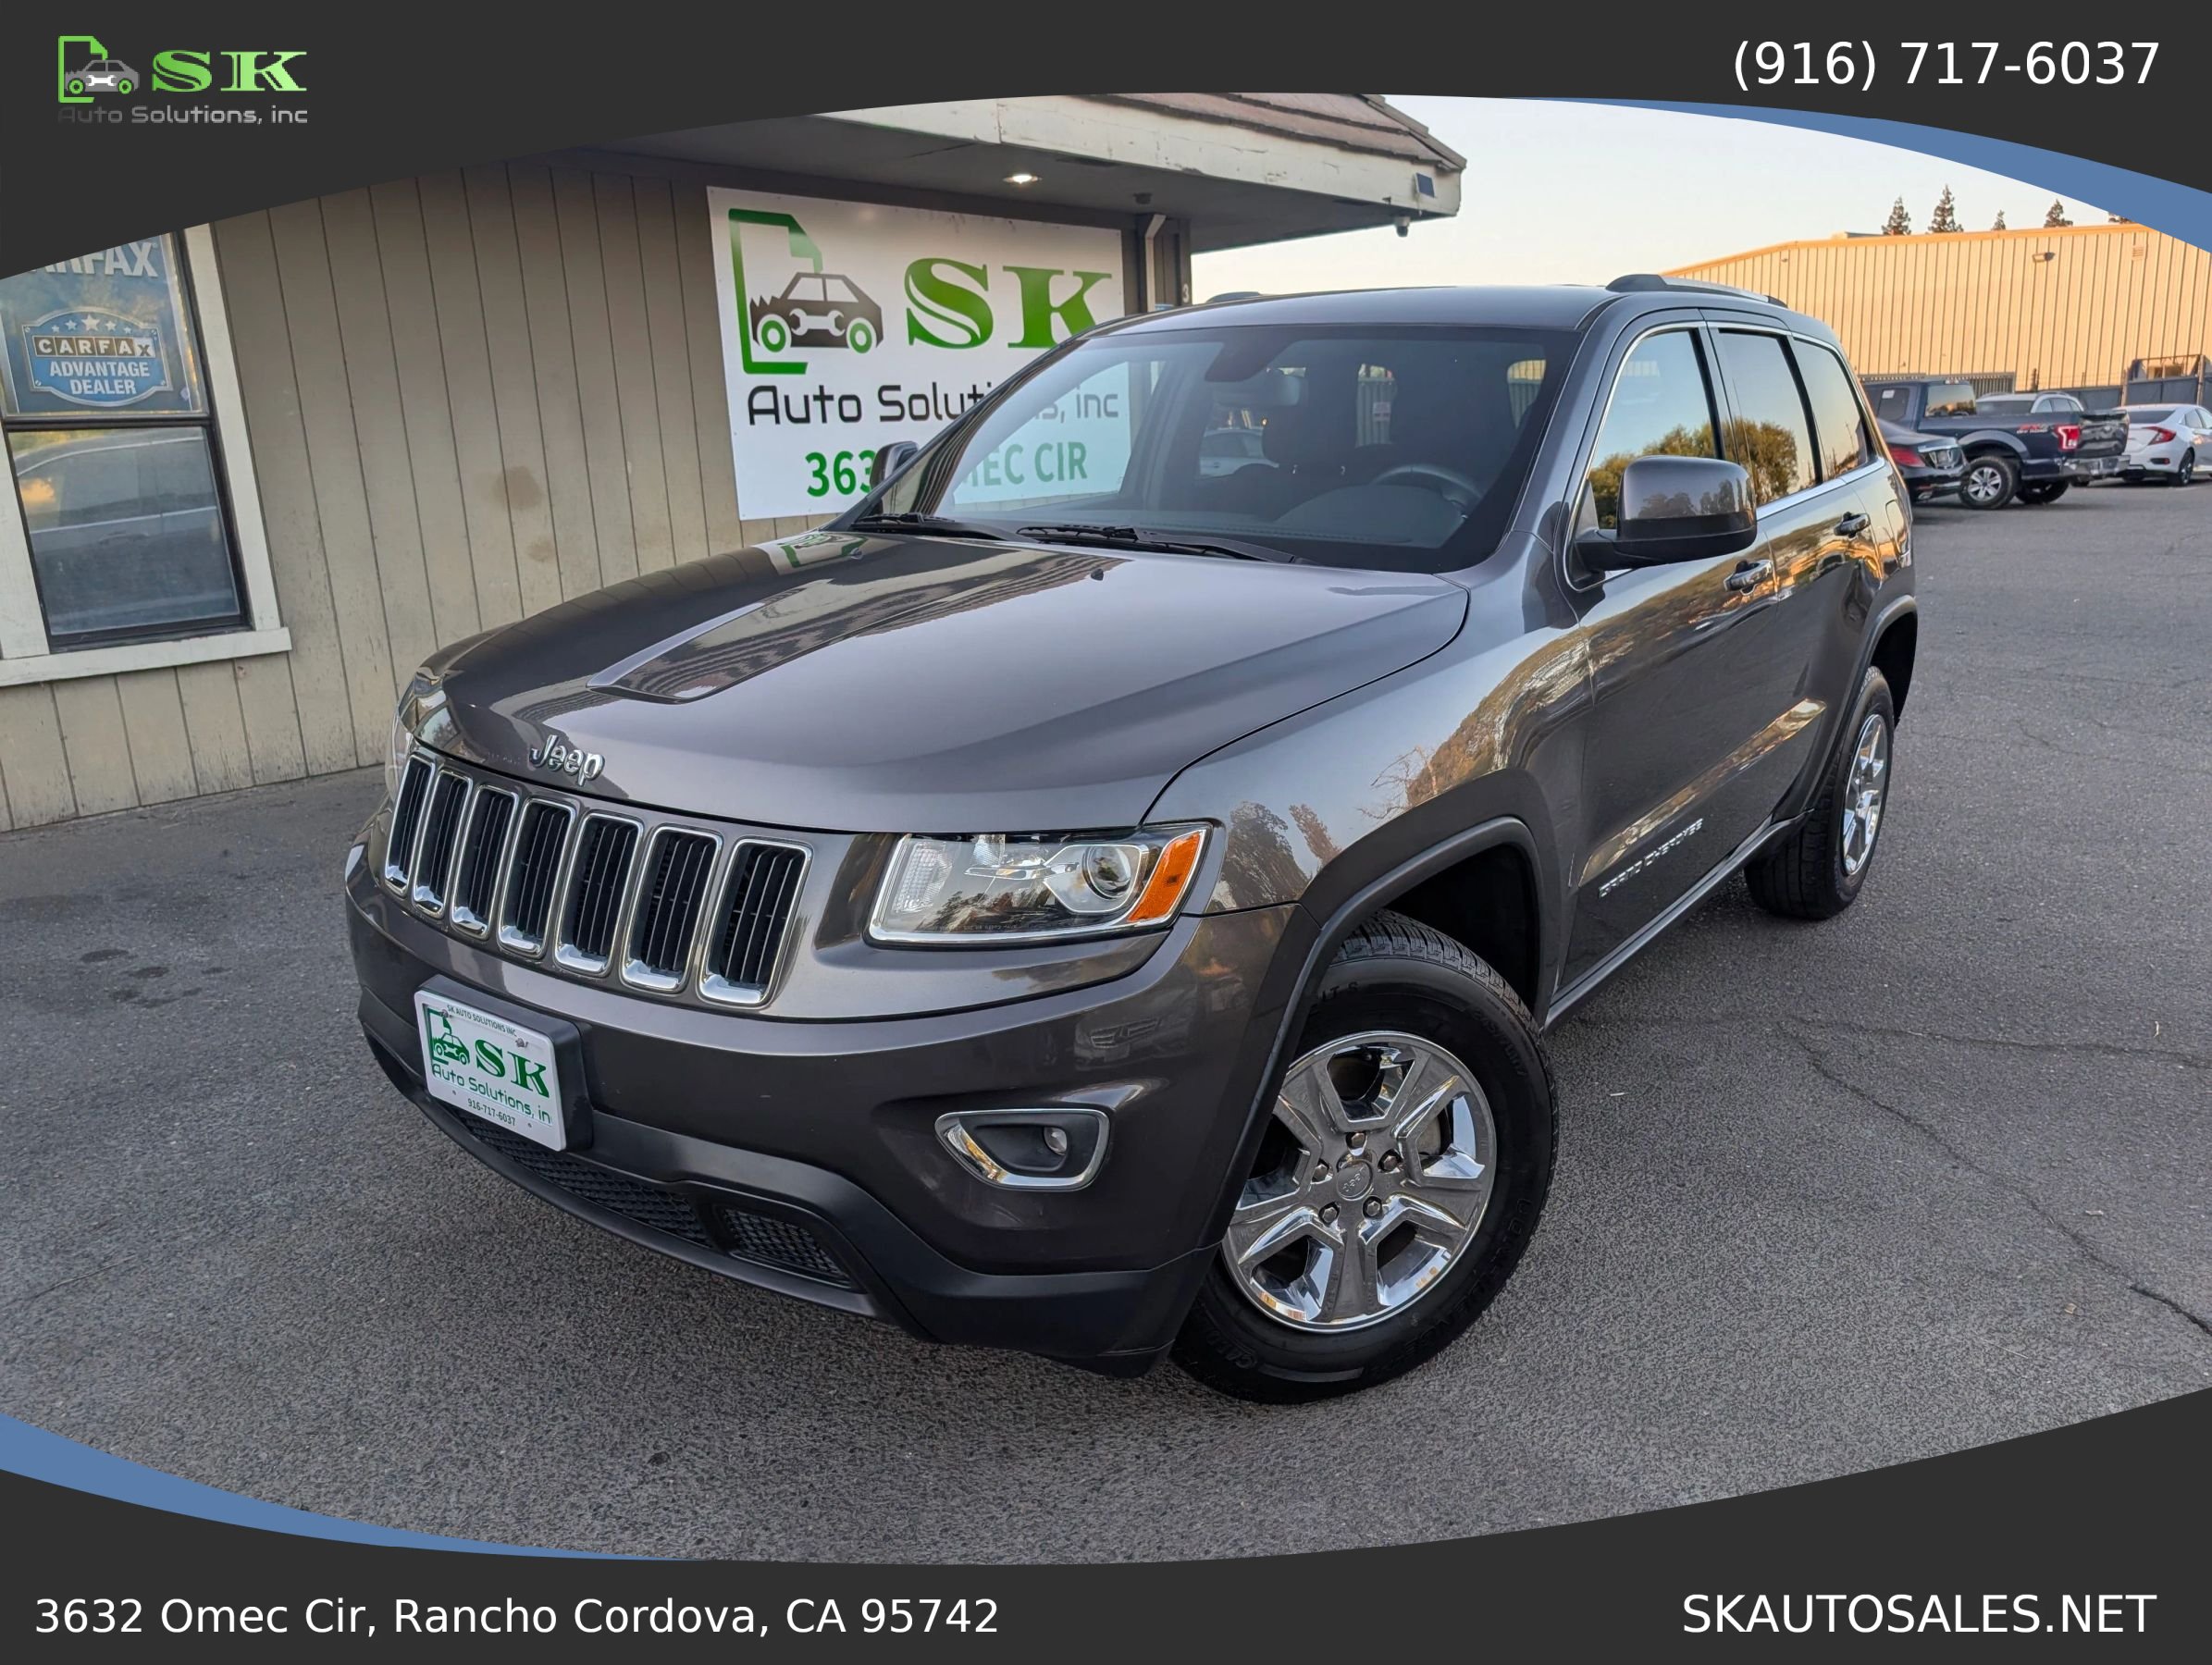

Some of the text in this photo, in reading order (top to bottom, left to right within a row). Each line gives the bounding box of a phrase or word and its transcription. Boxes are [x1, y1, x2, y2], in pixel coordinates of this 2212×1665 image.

[904, 257, 1113, 350] SK
[38, 339, 152, 357] CARFAX
[49, 361, 151, 377] ADVANTAGE
[69, 379, 137, 395] DEALER
[748, 384, 862, 426] Auto
[1075, 384, 1119, 419] inc
[805, 449, 876, 498] 363
[1033, 440, 1088, 483] CIR
[529, 734, 606, 787] Jeep
[447, 1005, 517, 1037] SK AUTO SOLUTIONS INC
[475, 1039, 550, 1098] SK
[431, 1064, 553, 1125] Auto Solutions, in
[467, 1098, 516, 1126] 916-717-6037
